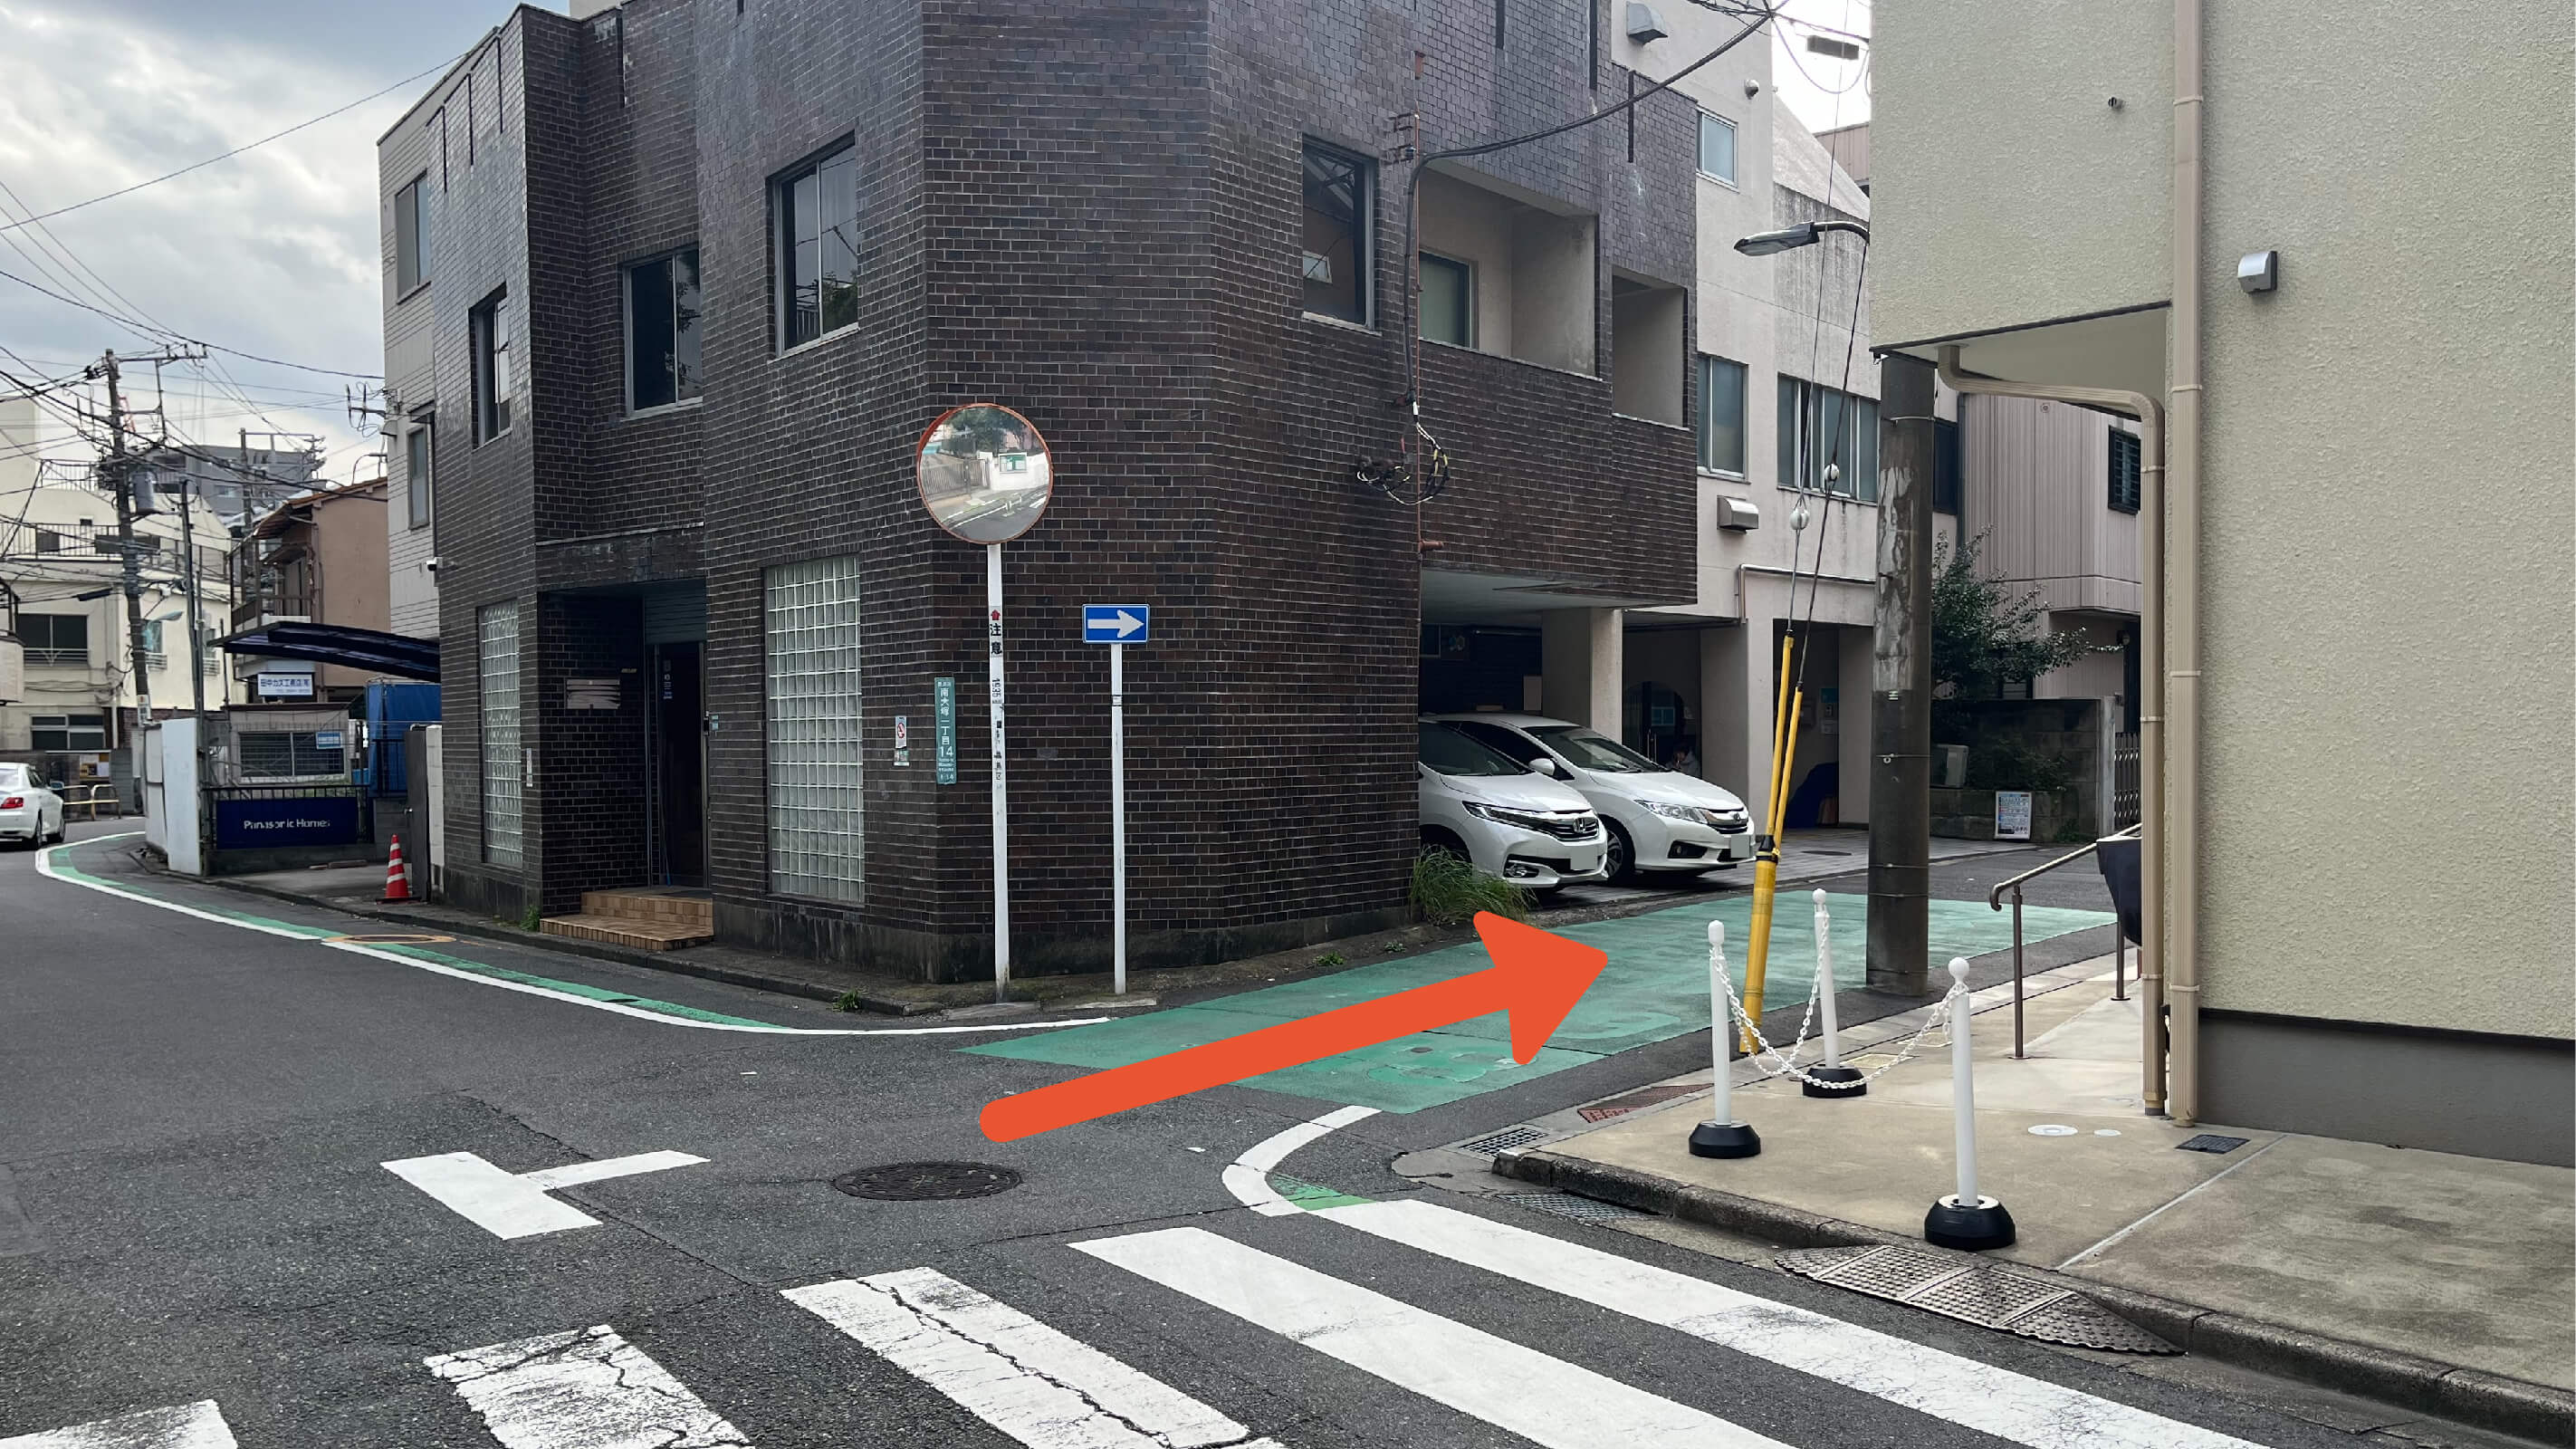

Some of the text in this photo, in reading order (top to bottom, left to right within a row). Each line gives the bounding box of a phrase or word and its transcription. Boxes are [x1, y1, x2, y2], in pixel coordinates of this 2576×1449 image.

[990, 623, 1002, 655] 注意
[939, 746, 954, 758] 14
[244, 819, 330, 830] Panasonic Homes
